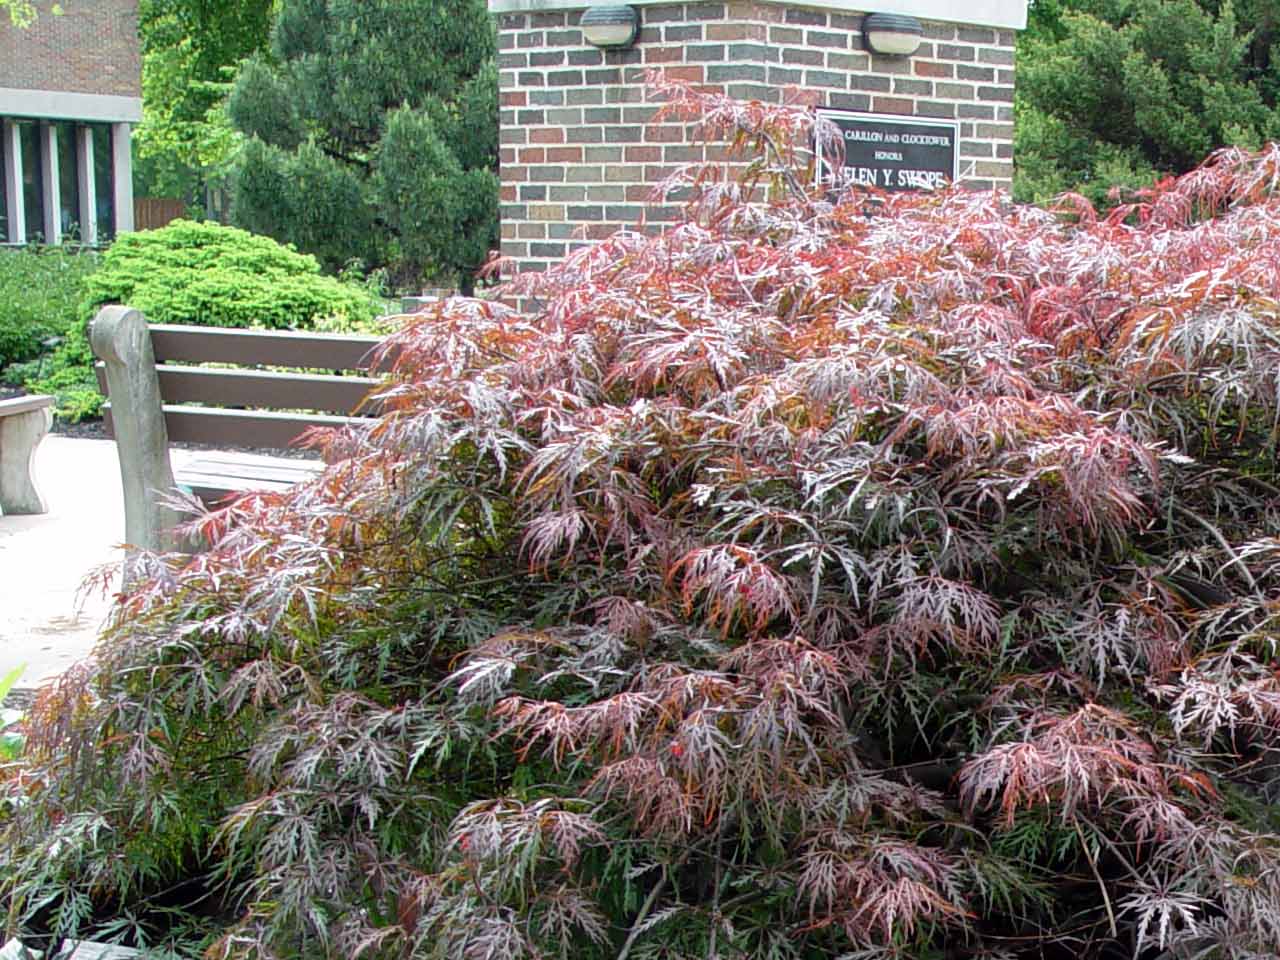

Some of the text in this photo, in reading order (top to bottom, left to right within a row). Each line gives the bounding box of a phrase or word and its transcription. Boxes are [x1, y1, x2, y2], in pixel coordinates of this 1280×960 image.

[884, 133, 900, 143] AND
[901, 134, 950, 146] CLOCKTOWER
[836, 166, 944, 189] ELEN Y. SWOPE
